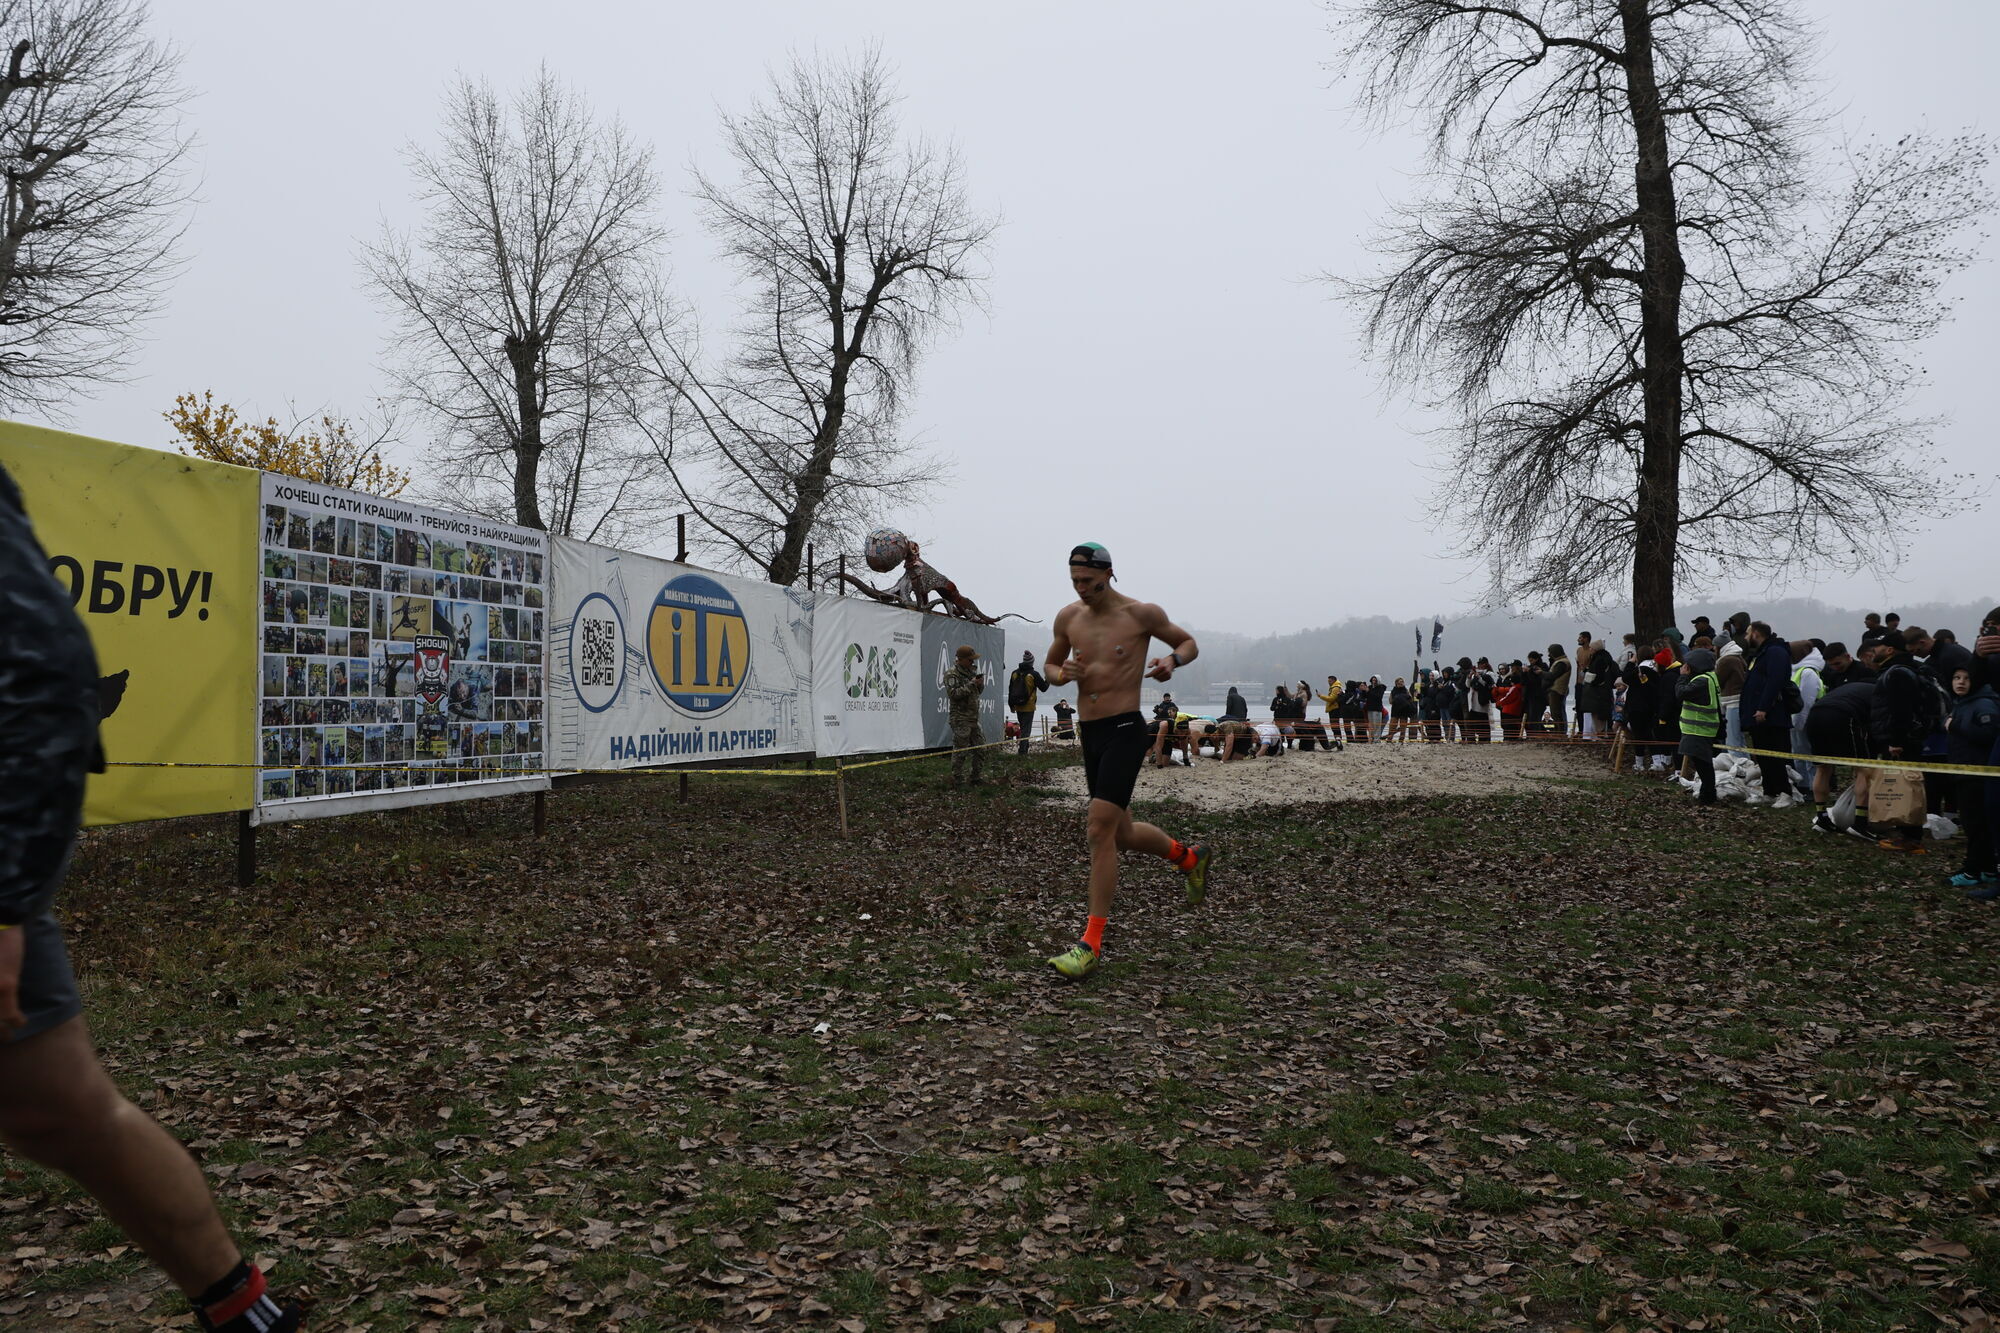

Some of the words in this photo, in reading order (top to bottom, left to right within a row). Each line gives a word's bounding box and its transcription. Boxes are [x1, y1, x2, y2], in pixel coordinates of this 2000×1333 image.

[275, 485, 320, 506] ХОЧЕШ
[323, 495, 361, 513] СТАТИ
[364, 503, 412, 524] КРАЩИМ
[421, 515, 470, 535] ТРЕНУЙСЯ
[480, 528, 541, 548] НАЙКРАЩИМИ
[46, 555, 213, 621] ОБРУ!
[416, 638, 448, 651] SHOGUN
[843, 643, 898, 698] CAS
[844, 701, 866, 712] CREATIVE
[868, 701, 881, 712] AGRO
[882, 701, 898, 712] SERVICE
[610, 726, 703, 762] НАДІЙНИЙ
[708, 729, 777, 752] ПАРТНЕР!
